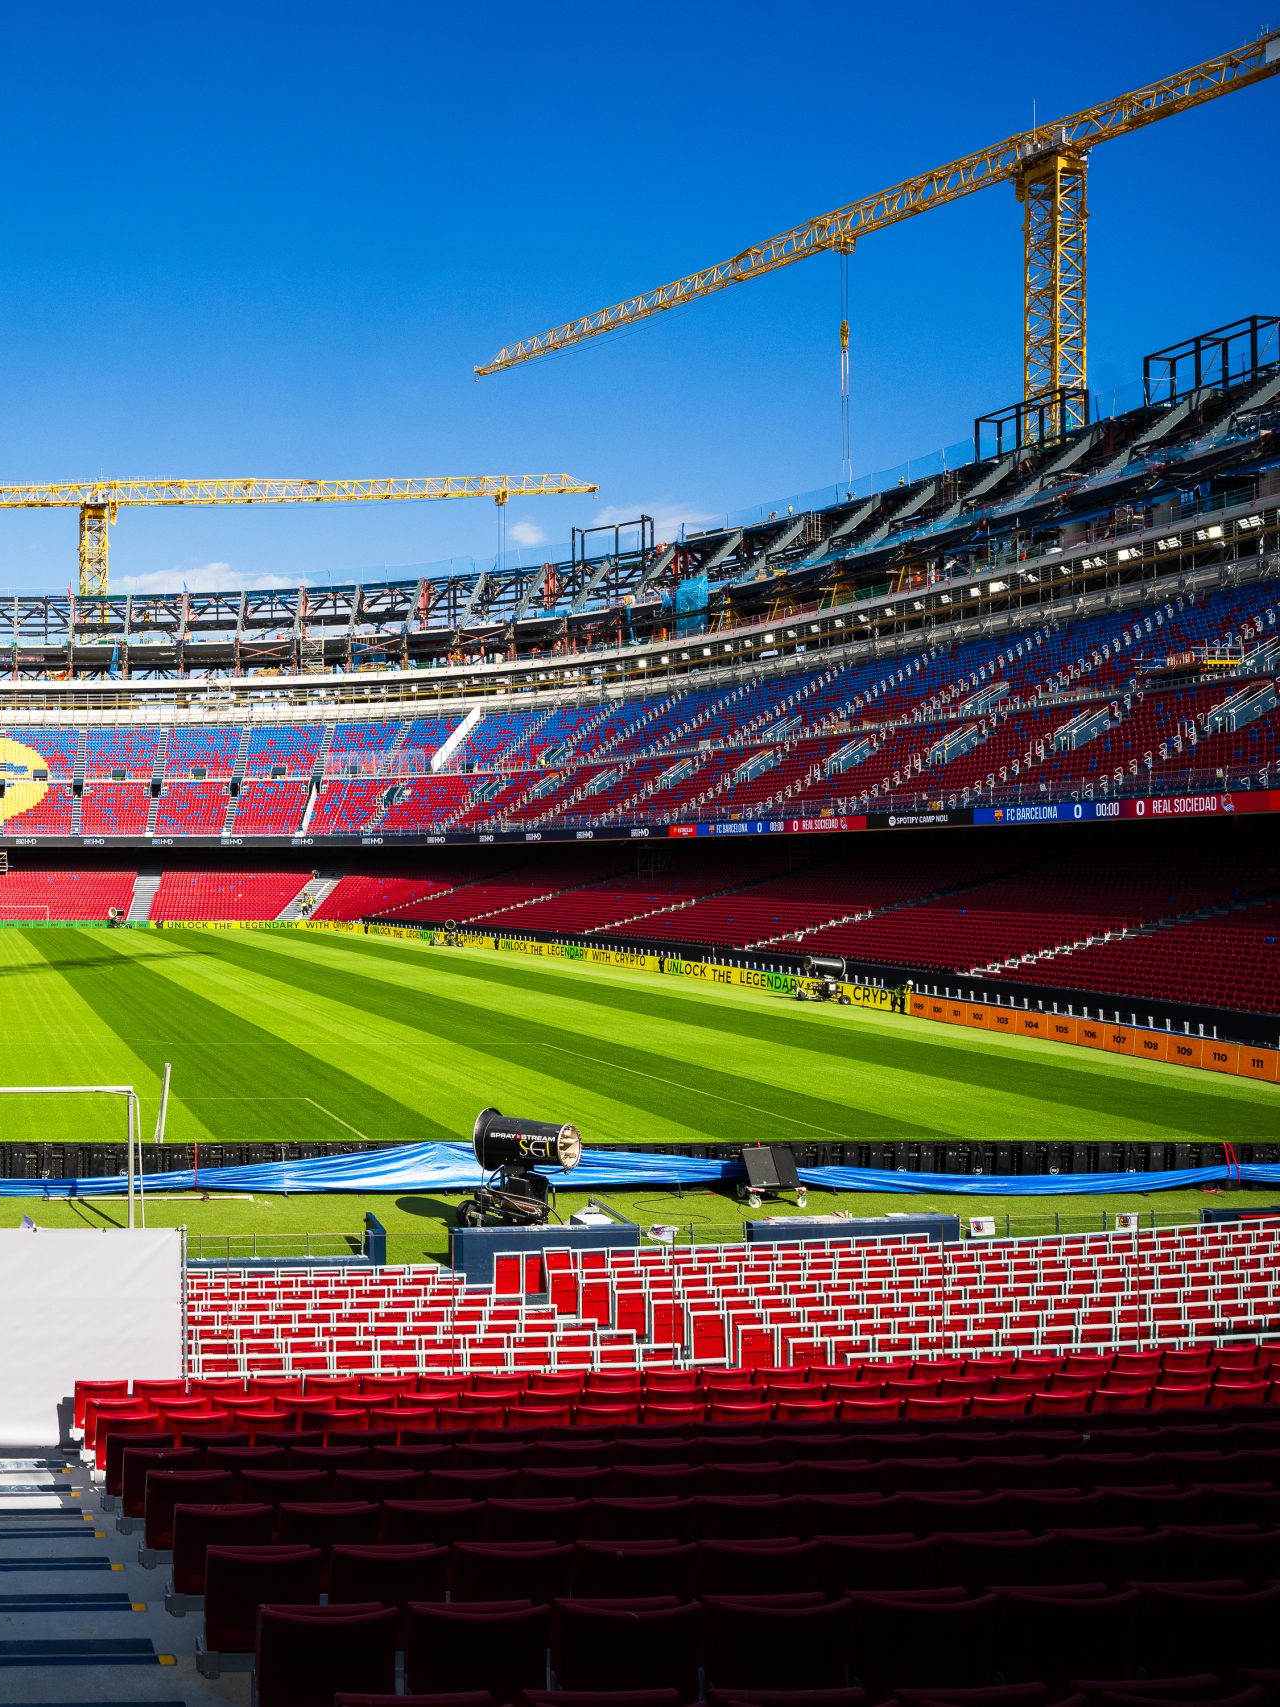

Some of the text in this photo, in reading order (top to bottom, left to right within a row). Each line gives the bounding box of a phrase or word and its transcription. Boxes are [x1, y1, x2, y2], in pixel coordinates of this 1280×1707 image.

[1006, 796, 1217, 821] FC BARCELONA 0 00:00 0 REAL SOCIEDAD
[896, 816, 918, 825] SPOTIFY
[936, 814, 948, 822] NOU
[717, 825, 722, 833] FC
[722, 823, 748, 833] BARCELONA
[793, 821, 798, 831] 0
[802, 819, 813, 830] REAL
[814, 817, 838, 830] SOCIEDAD
[168, 921, 208, 929] UNLOCK
[370, 926, 391, 935] UNLOCK
[394, 930, 403, 938] THE
[460, 934, 484, 945] CRYPTO
[501, 940, 646, 966] UNLOCK THE LEGENDARY WITH CRYPTO
[667, 960, 706, 978] UNLOCK
[712, 969, 732, 983] THE
[740, 970, 804, 992] LEGENDARY
[854, 986, 899, 1006] CRYPT
[997, 1016, 1008, 1024] 103
[1024, 1020, 1039, 1029] 104
[1055, 1025, 1068, 1034] 105
[1084, 1030, 1096, 1038] 106
[1112, 1035, 1126, 1044] 107
[1144, 1040, 1158, 1050] 108
[1177, 1046, 1192, 1056] 109
[1213, 1052, 1227, 1062] 110
[1252, 1058, 1263, 1068] 111
[521, 1134, 556, 1142] STREAM
